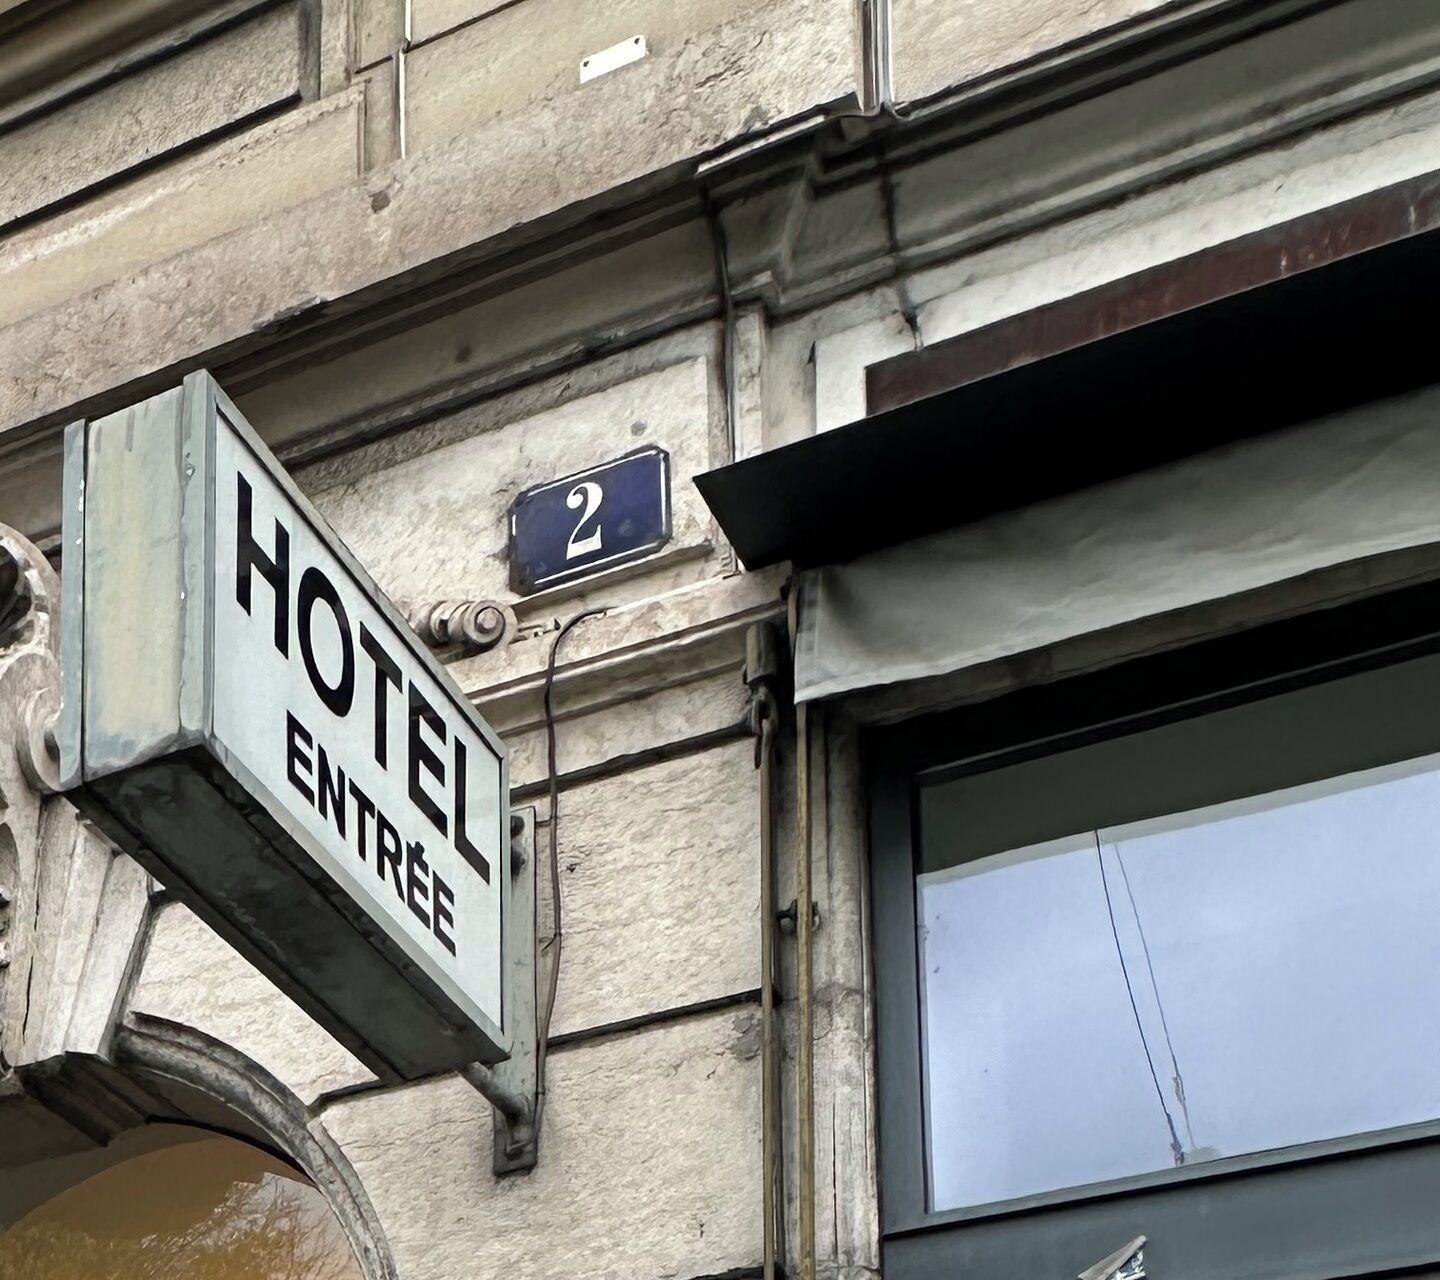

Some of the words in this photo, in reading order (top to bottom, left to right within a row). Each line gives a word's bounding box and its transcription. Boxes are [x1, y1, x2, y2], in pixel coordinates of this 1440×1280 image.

[565, 481, 603, 560] 2
[236, 471, 490, 886] HOTEL
[286, 710, 457, 957] ENTRÉE
